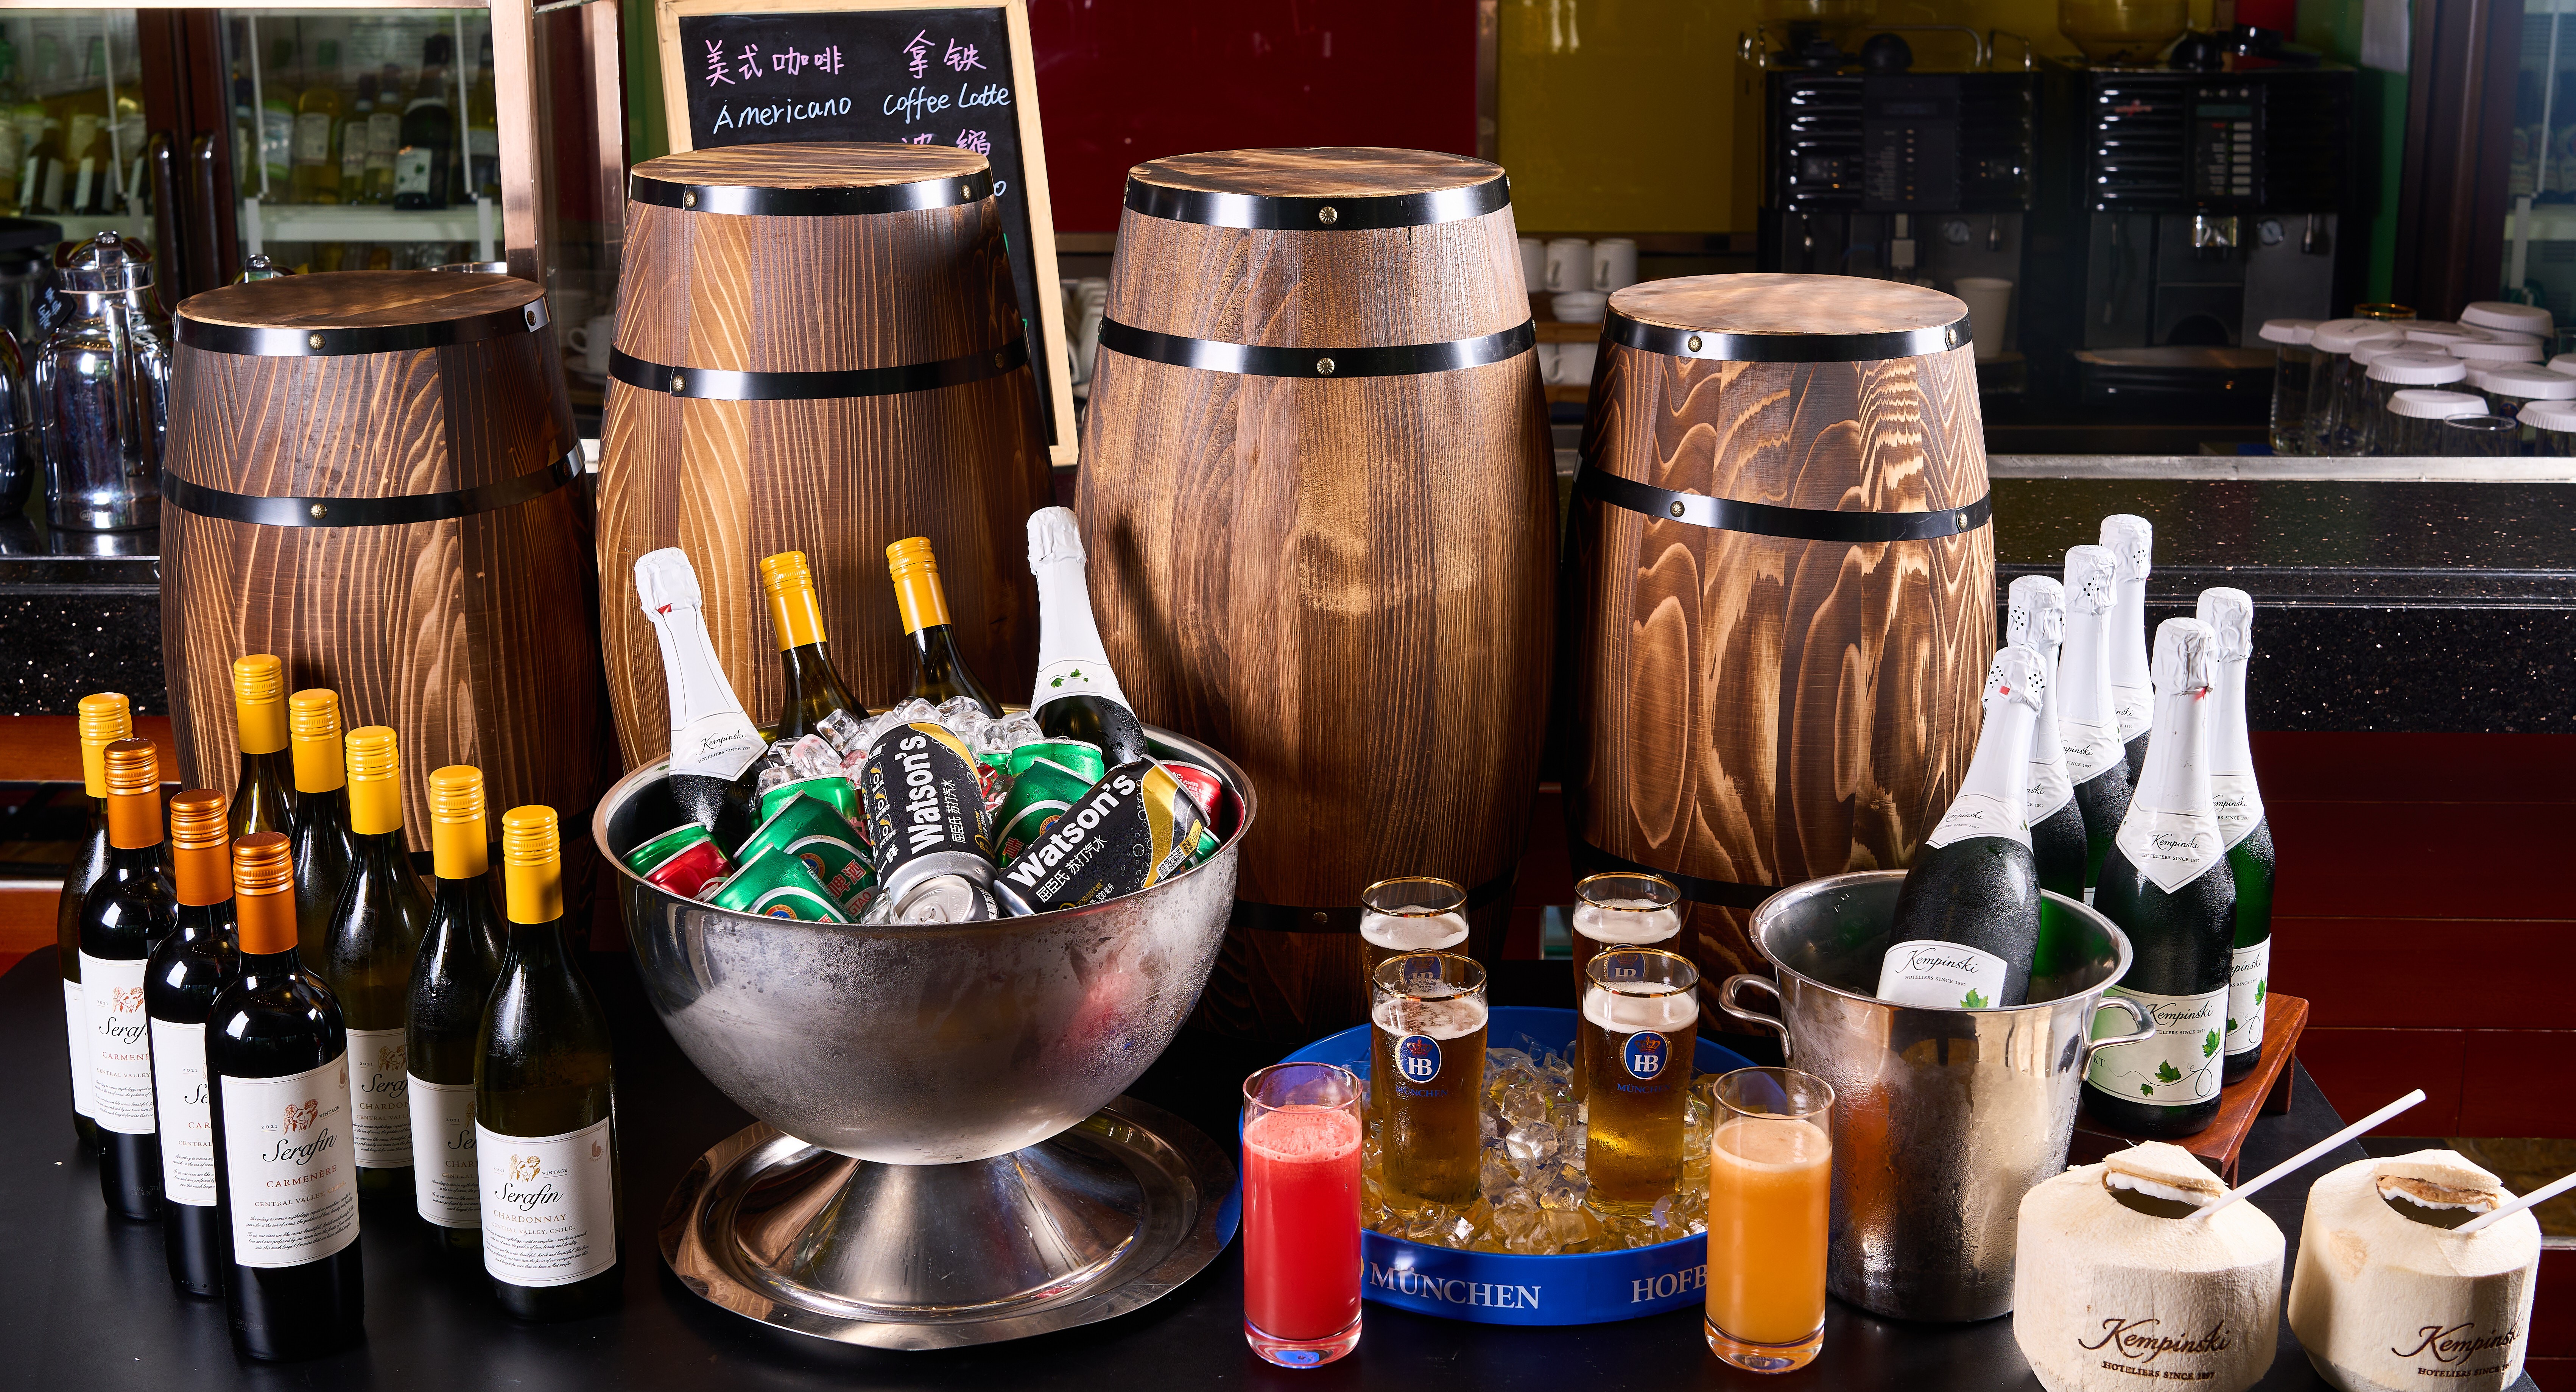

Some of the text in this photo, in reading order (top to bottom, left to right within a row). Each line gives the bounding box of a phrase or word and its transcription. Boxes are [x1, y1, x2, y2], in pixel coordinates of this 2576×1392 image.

[706, 39, 844, 87] 美式咖啡
[903, 29, 986, 79] 拿铁
[883, 83, 1011, 123] Coffee Latte
[713, 97, 851, 134] Americano
[2115, 706, 2134, 717] inski
[696, 729, 746, 756] Kempinski
[2062, 744, 2093, 756] mpinski
[698, 750, 724, 763] HOTELIERS
[895, 735, 947, 855] Watson's
[942, 779, 966, 843] 屈臣氏 苏打汽水
[1006, 775, 1135, 887] Watson's
[2149, 834, 2200, 851] Kempinski
[827, 859, 866, 898] 啤酒
[1036, 870, 1070, 903] 屈臣氏
[1065, 834, 1107, 875] 苏打汽水
[849, 891, 871, 915] GTAO
[1895, 948, 1979, 973] Kempinski
[2232, 951, 2263, 977] pinski
[2146, 1001, 2213, 1027] Kempinski
[99, 1017, 148, 1044] Seraf
[103, 1052, 149, 1060] CARMENÈ
[1408, 1057, 1432, 1076] HB
[1634, 1054, 1658, 1072] HB
[2094, 1054, 2105, 1067] KT
[97, 1068, 121, 1077] CENTRAL
[361, 1074, 408, 1098] Seraf
[1395, 1084, 1448, 1097] MÜNCHEN
[1617, 1083, 1671, 1093] MÜNCHEN
[319, 1105, 340, 1118] VINTAGE
[360, 1101, 410, 1110] CHARDON
[262, 1128, 337, 1166] Serafin
[267, 1164, 337, 1188] CARMENÈRE
[495, 1182, 564, 1211] Serafin
[492, 1222, 517, 1233] CENTRAL
[494, 1210, 566, 1223] CHARDONNAY
[1369, 1260, 1707, 1309] MÜNCHEN HOFB
[2078, 1319, 2231, 1363] Kempinski
[2392, 1311, 2524, 1366] Kempinski
[2101, 1361, 2160, 1378] HOTELIERS
[2163, 1371, 2194, 1380] SINCE
[2418, 1367, 2471, 1377] HOTELIERS
[2474, 1366, 2498, 1375] SINCE
